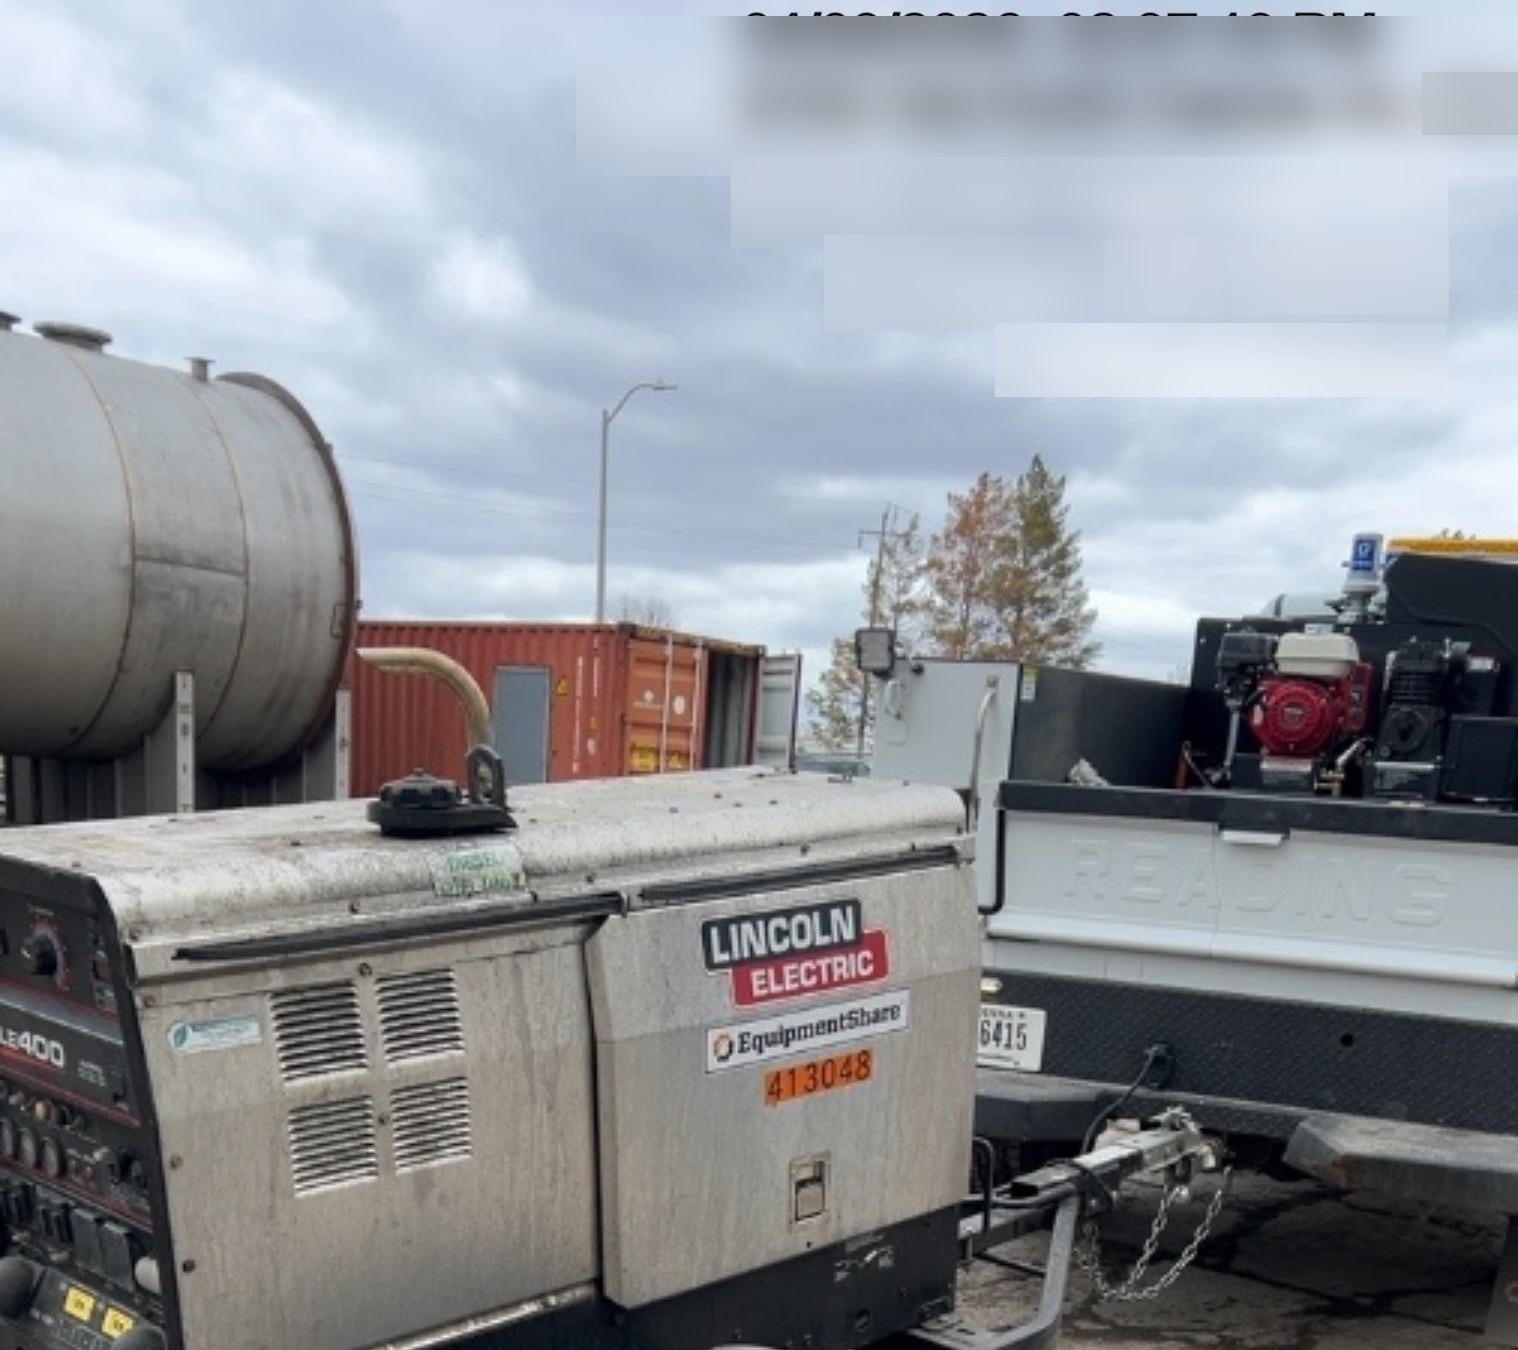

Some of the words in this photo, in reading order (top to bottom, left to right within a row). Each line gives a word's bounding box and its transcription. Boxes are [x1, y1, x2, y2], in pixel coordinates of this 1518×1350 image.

[1063, 839, 1454, 927] READING
[710, 905, 856, 965] LINCOLN
[751, 949, 874, 998] ELECTRIC
[738, 1004, 901, 1055] EquipmentShare
[980, 1019, 1027, 1051] 6415
[767, 1049, 871, 1099] 413048
